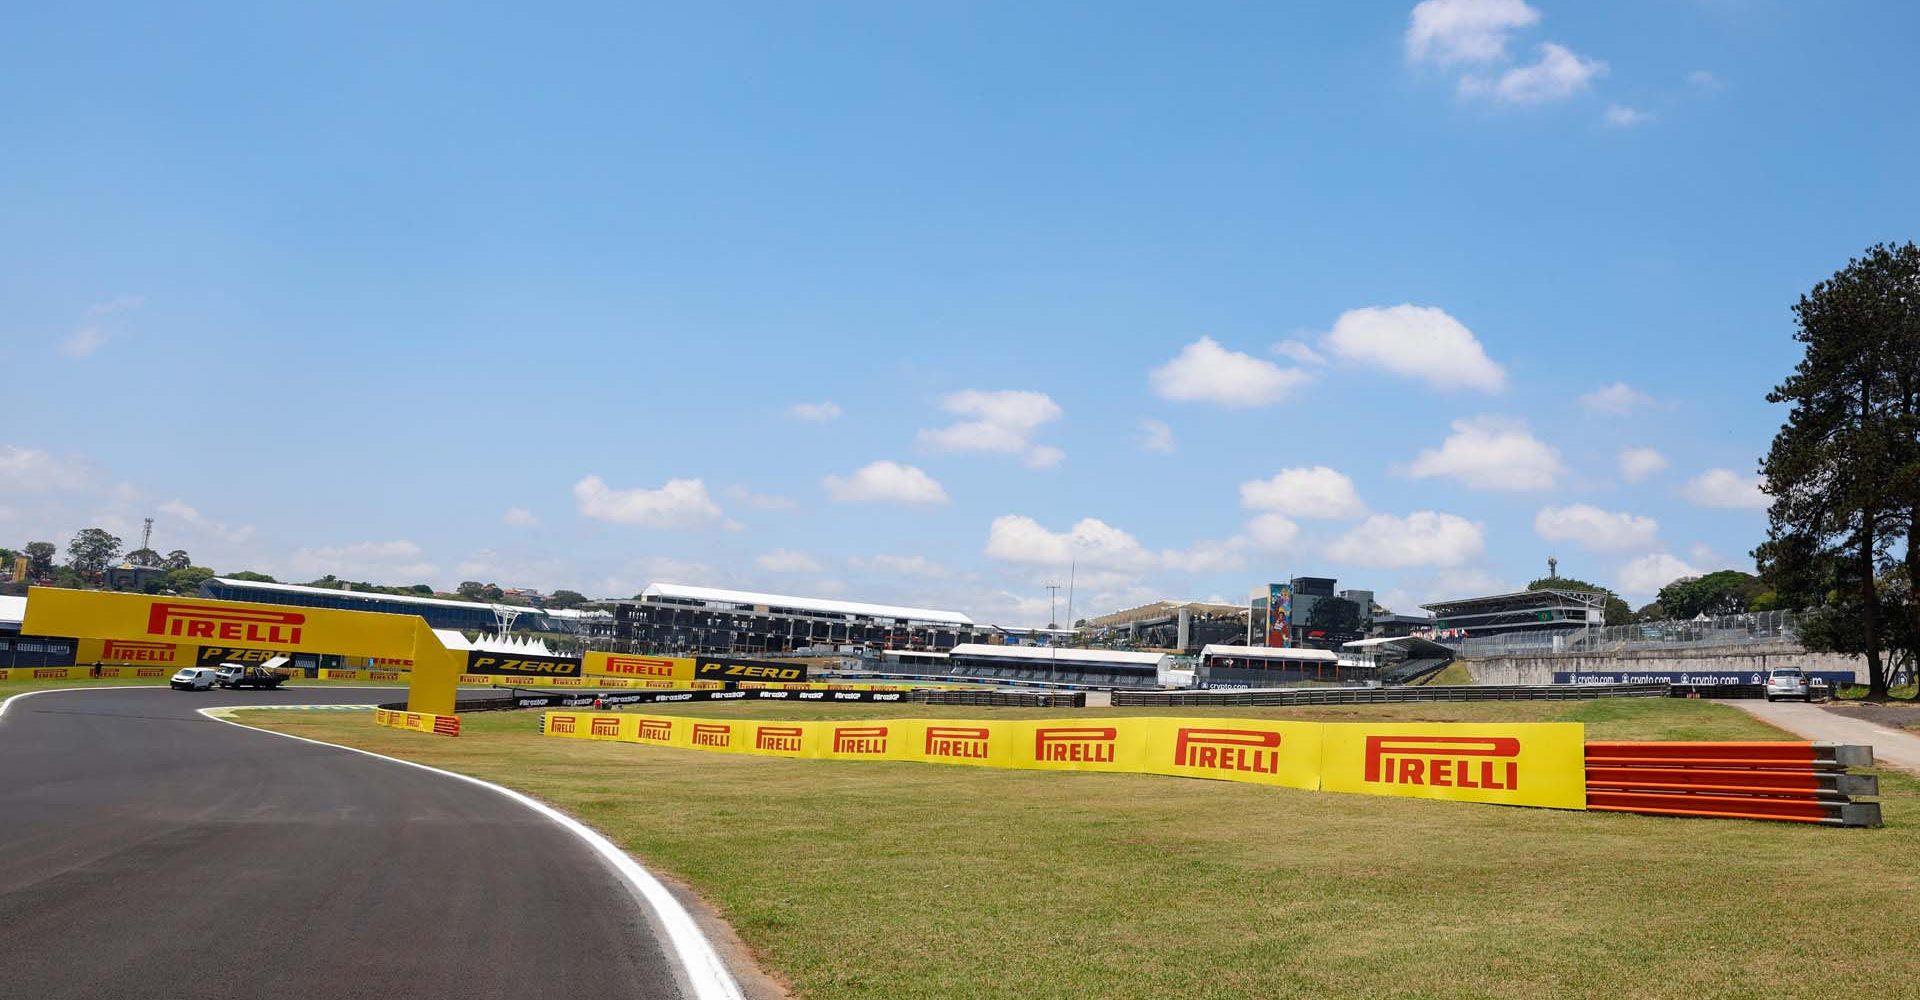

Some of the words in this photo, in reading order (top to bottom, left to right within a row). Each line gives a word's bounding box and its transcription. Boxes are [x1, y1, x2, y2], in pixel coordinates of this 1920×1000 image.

[146, 602, 305, 645] PIRELLI
[103, 639, 177, 662] PIRELLI
[203, 647, 223, 659] P
[89, 669, 119, 677] PELLI
[473, 657, 496, 668] P
[499, 660, 577, 674] ZERO
[606, 657, 673, 676] PIRELLI
[700, 663, 721, 673] P
[725, 665, 801, 679] ZERO
[1578, 676, 1614, 684] crypto.com
[1630, 675, 1671, 684] crypto.com
[1690, 675, 1739, 685] crypto.com
[551, 716, 576, 733] PIRELLI
[591, 718, 620, 736] PIRELLI
[639, 720, 672, 741] PIRELLI
[693, 724, 731, 747] PIRELLI
[756, 726, 803, 752] PIRELLI
[833, 727, 888, 754] PIRELLI
[926, 727, 989, 759] PIRELLI
[1036, 728, 1117, 763] PIRELLI
[1174, 728, 1282, 774] PIRELLI
[1365, 736, 1521, 790] PIRELLI
